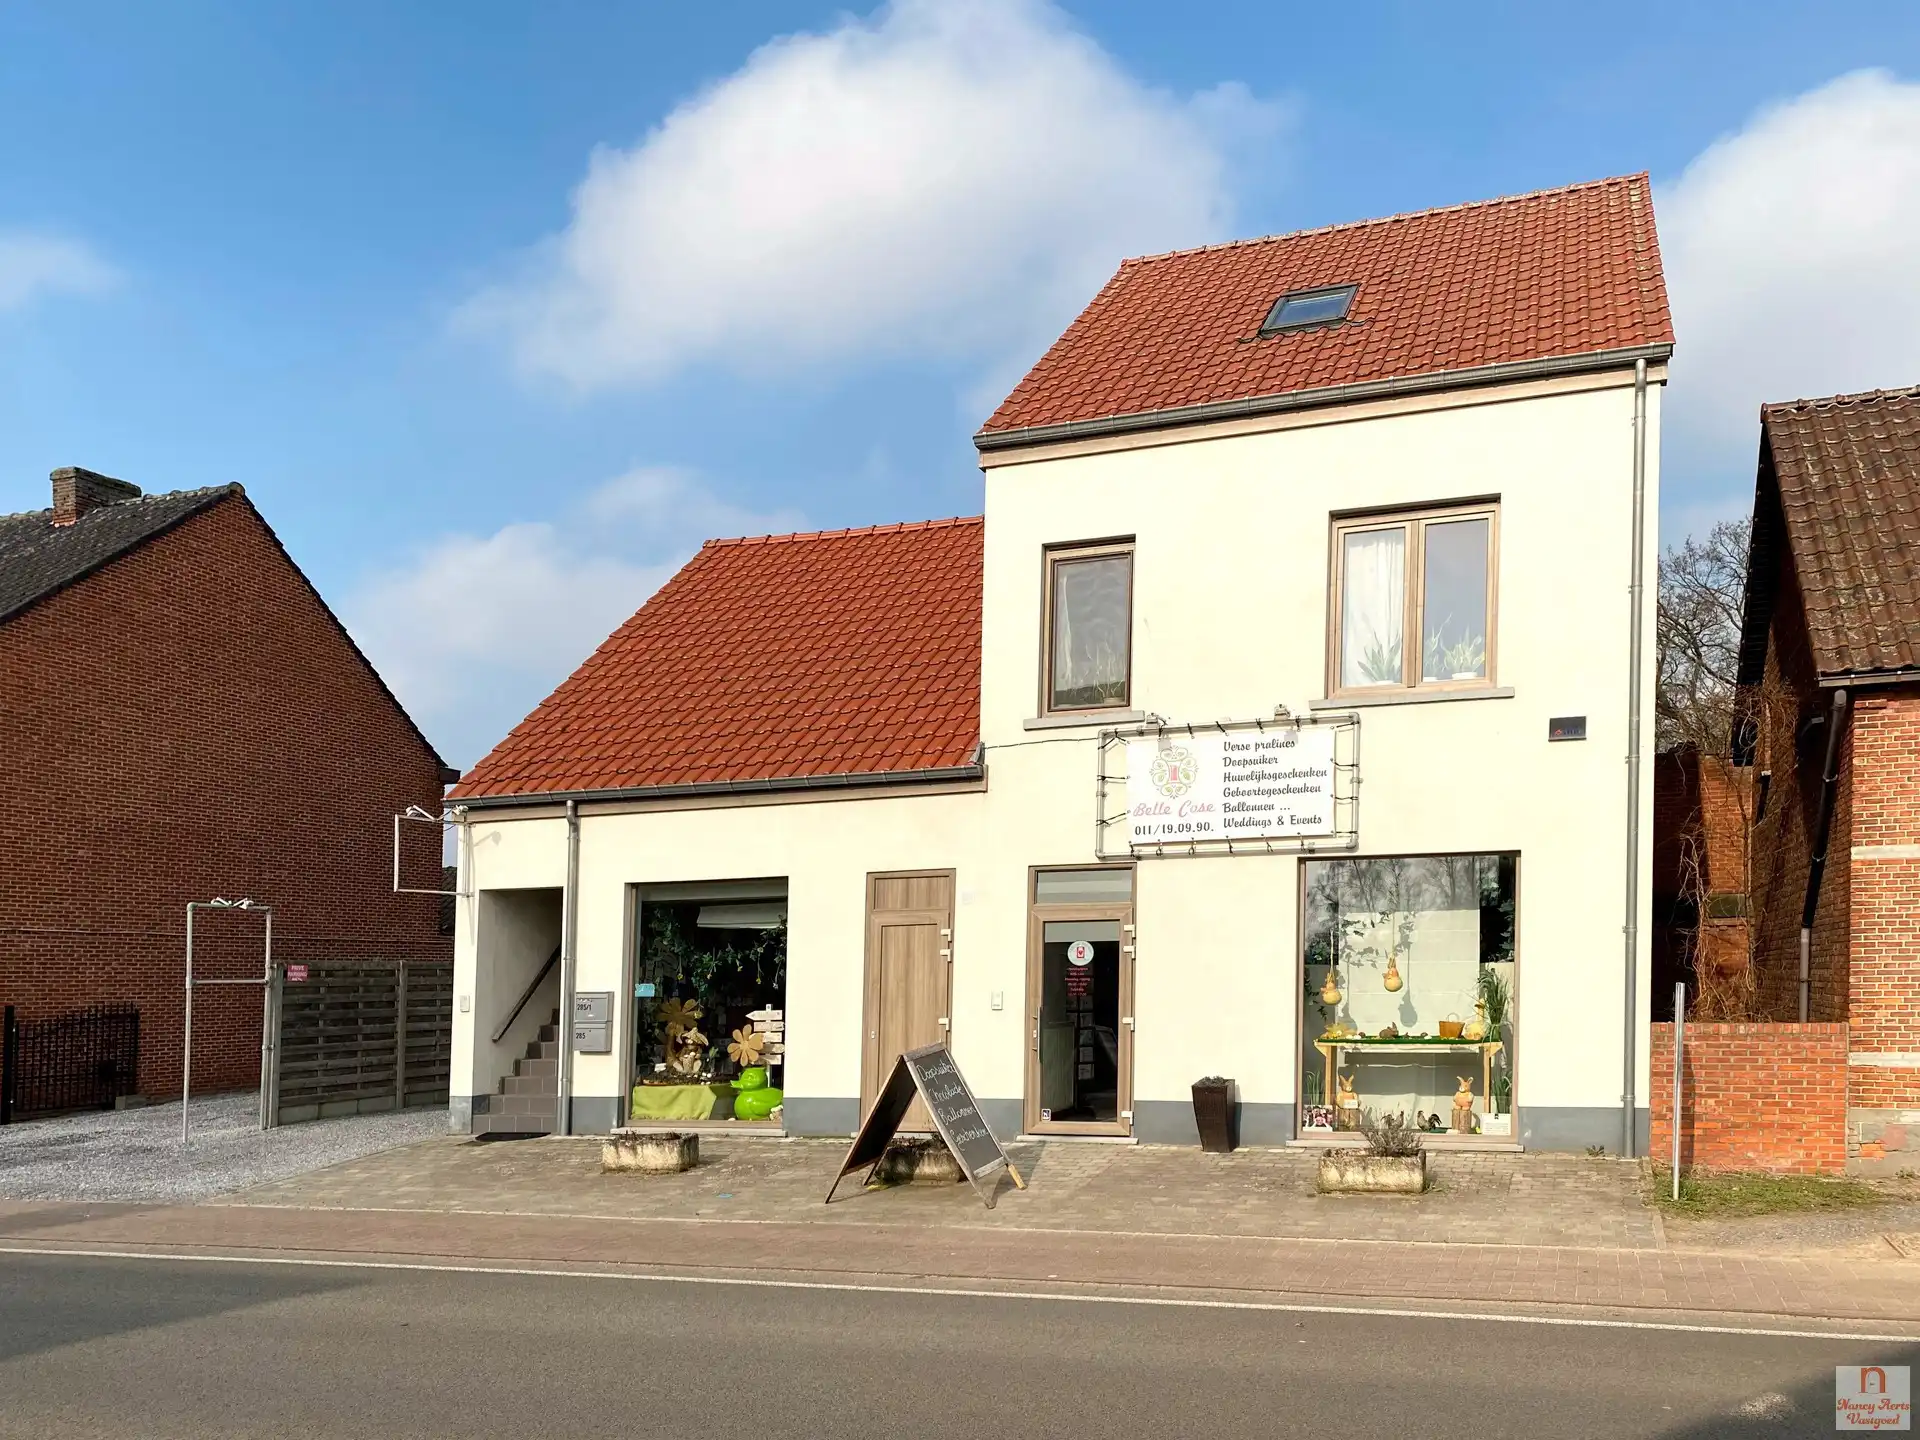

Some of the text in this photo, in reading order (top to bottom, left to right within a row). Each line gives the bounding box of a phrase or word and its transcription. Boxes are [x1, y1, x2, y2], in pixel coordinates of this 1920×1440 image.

[1223, 738, 1296, 752] Verse pralines
[1222, 754, 1279, 769] Doopsuiker
[1223, 767, 1328, 783] Huwelijksgeschenken
[1223, 783, 1322, 798] Geboortegeschenken
[1133, 801, 1172, 817] Belle
[1222, 801, 1276, 813] Ballonnen
[1223, 814, 1322, 828] Weddings & Events
[577, 1003, 592, 1011] 285/1
[575, 1032, 586, 1040] 285
